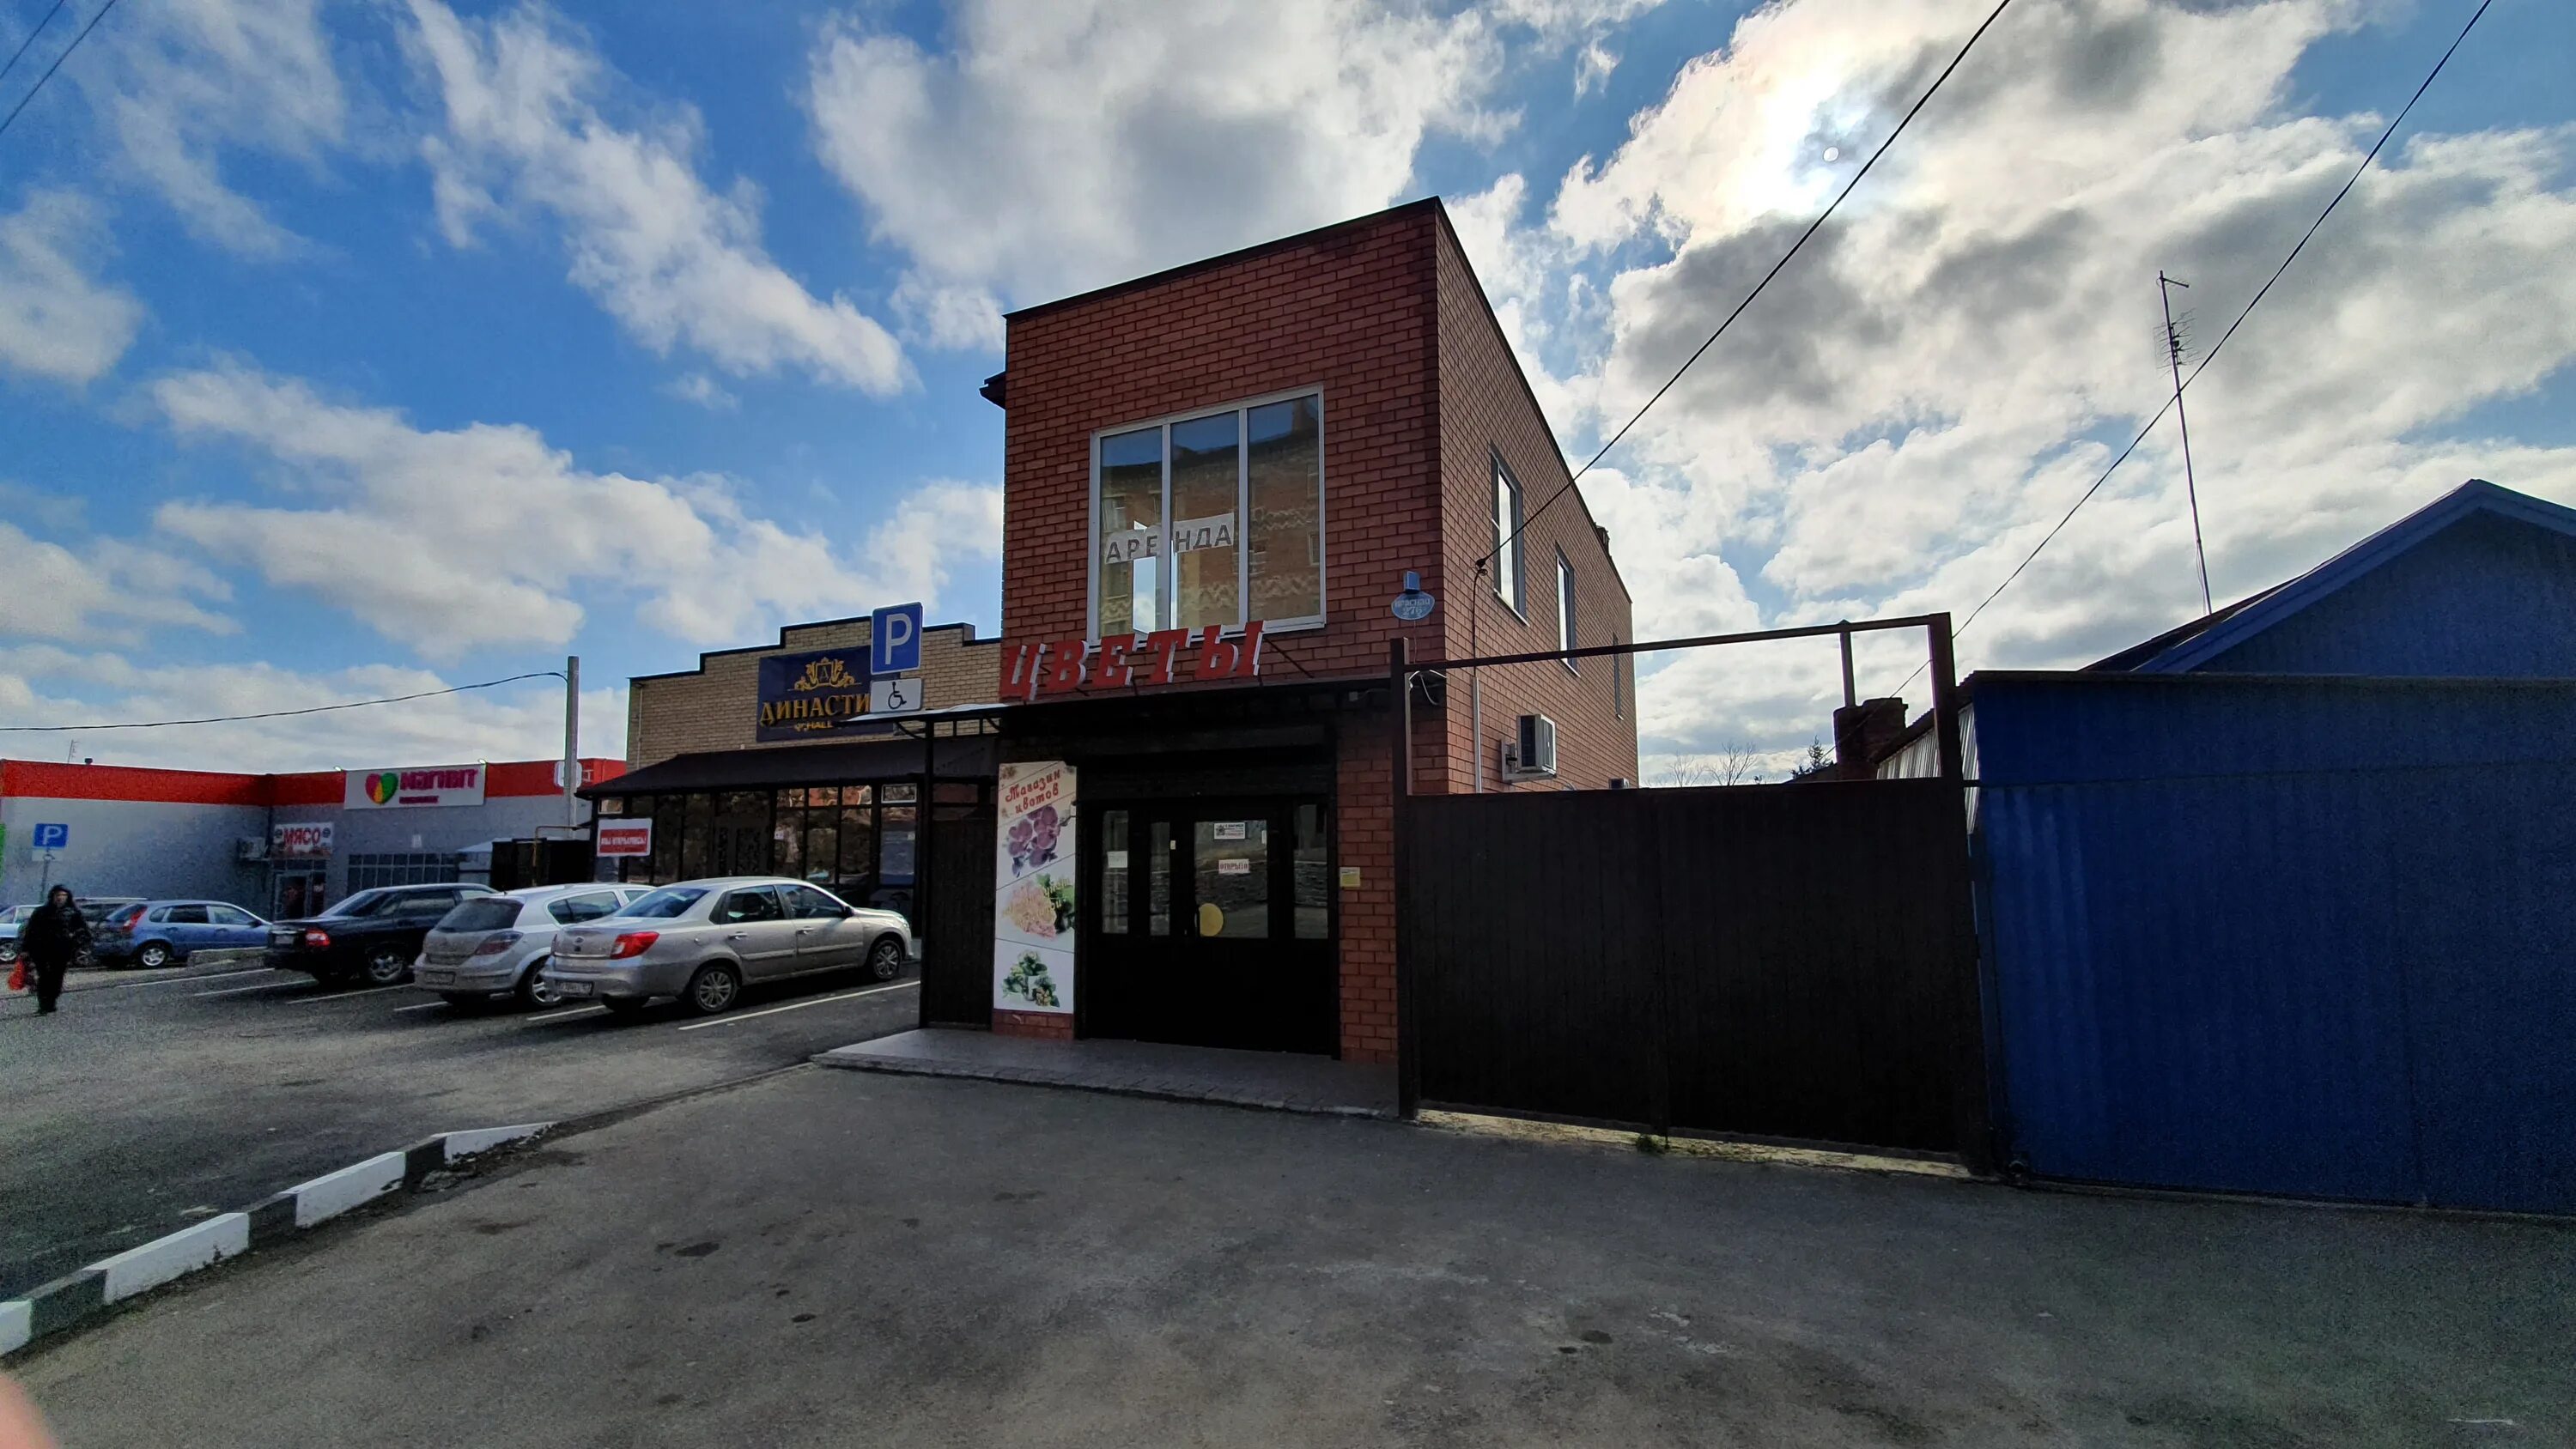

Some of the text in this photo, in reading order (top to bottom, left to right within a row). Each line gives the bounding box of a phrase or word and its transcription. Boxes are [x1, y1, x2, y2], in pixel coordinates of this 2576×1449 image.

[1106, 524, 1231, 563] АРЕНДА
[884, 613, 912, 665] P
[999, 620, 1264, 701] ЦВЕТЫ
[760, 694, 871, 727] ДИНАСТИ
[1005, 769, 1060, 803] Магазин
[42, 825, 63, 845] P
[283, 828, 320, 846] МЯСО
